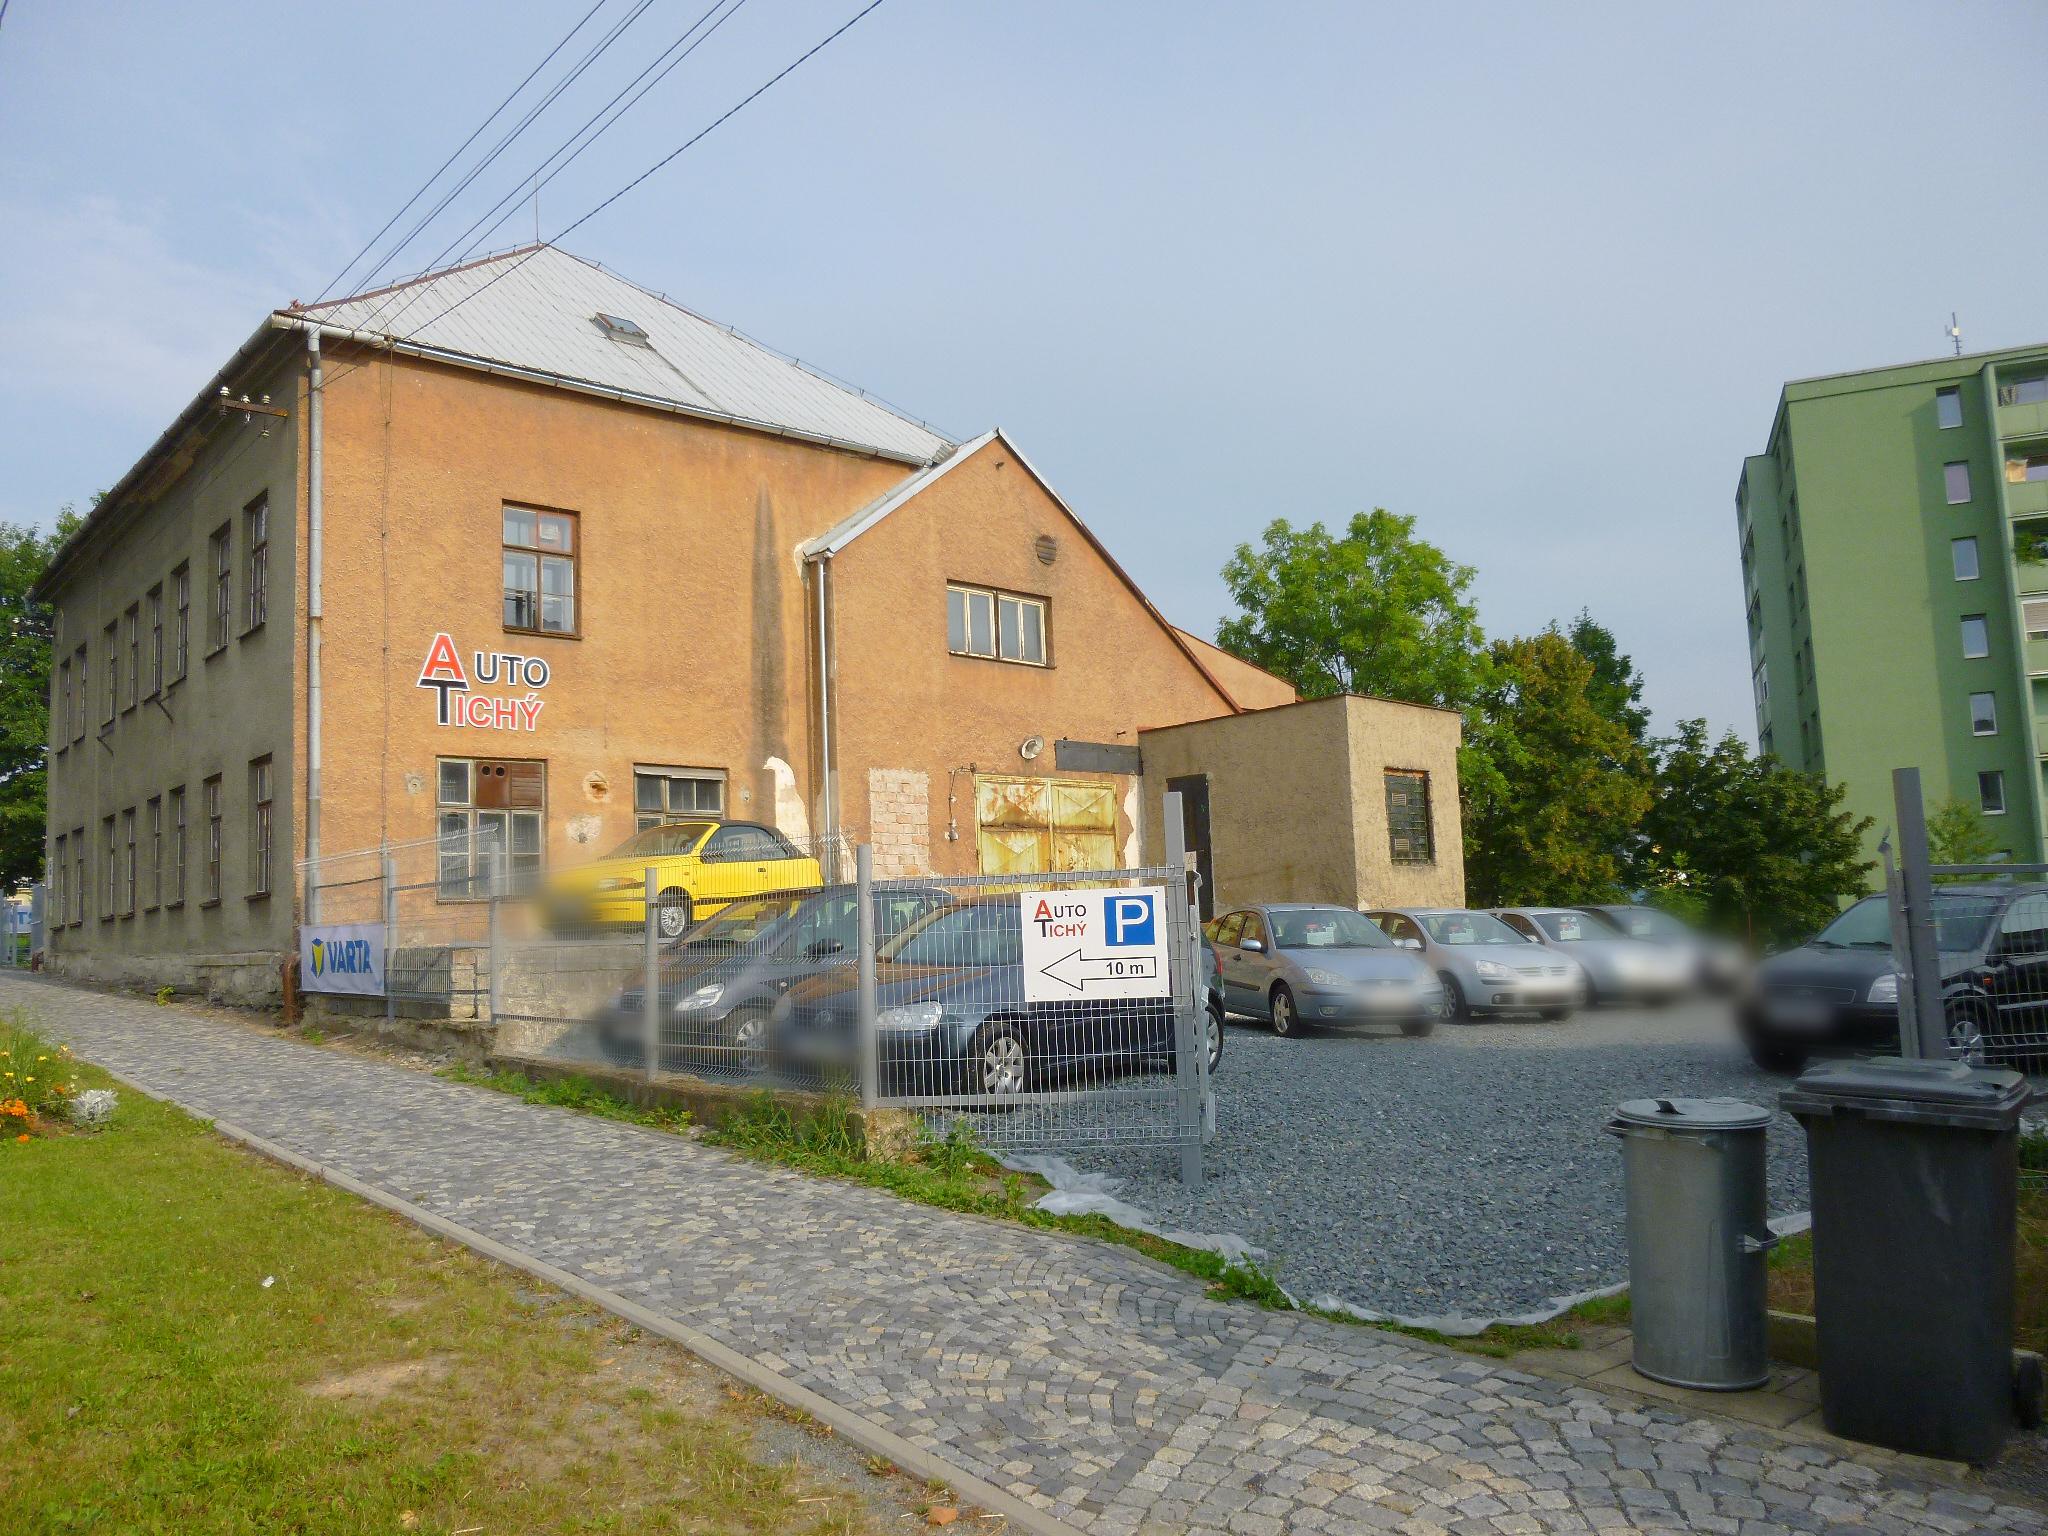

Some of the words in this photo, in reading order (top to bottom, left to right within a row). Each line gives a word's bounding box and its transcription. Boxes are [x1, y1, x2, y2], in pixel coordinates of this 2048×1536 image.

[419, 633, 550, 688] AUTO
[418, 678, 543, 731] TICHÝ
[1034, 899, 1087, 918] AUTO
[1115, 899, 1149, 943] P
[1033, 918, 1087, 937] TICHÝ
[326, 939, 373, 973] VARTA
[1106, 962, 1124, 975] 10
[1129, 963, 1144, 975] m
